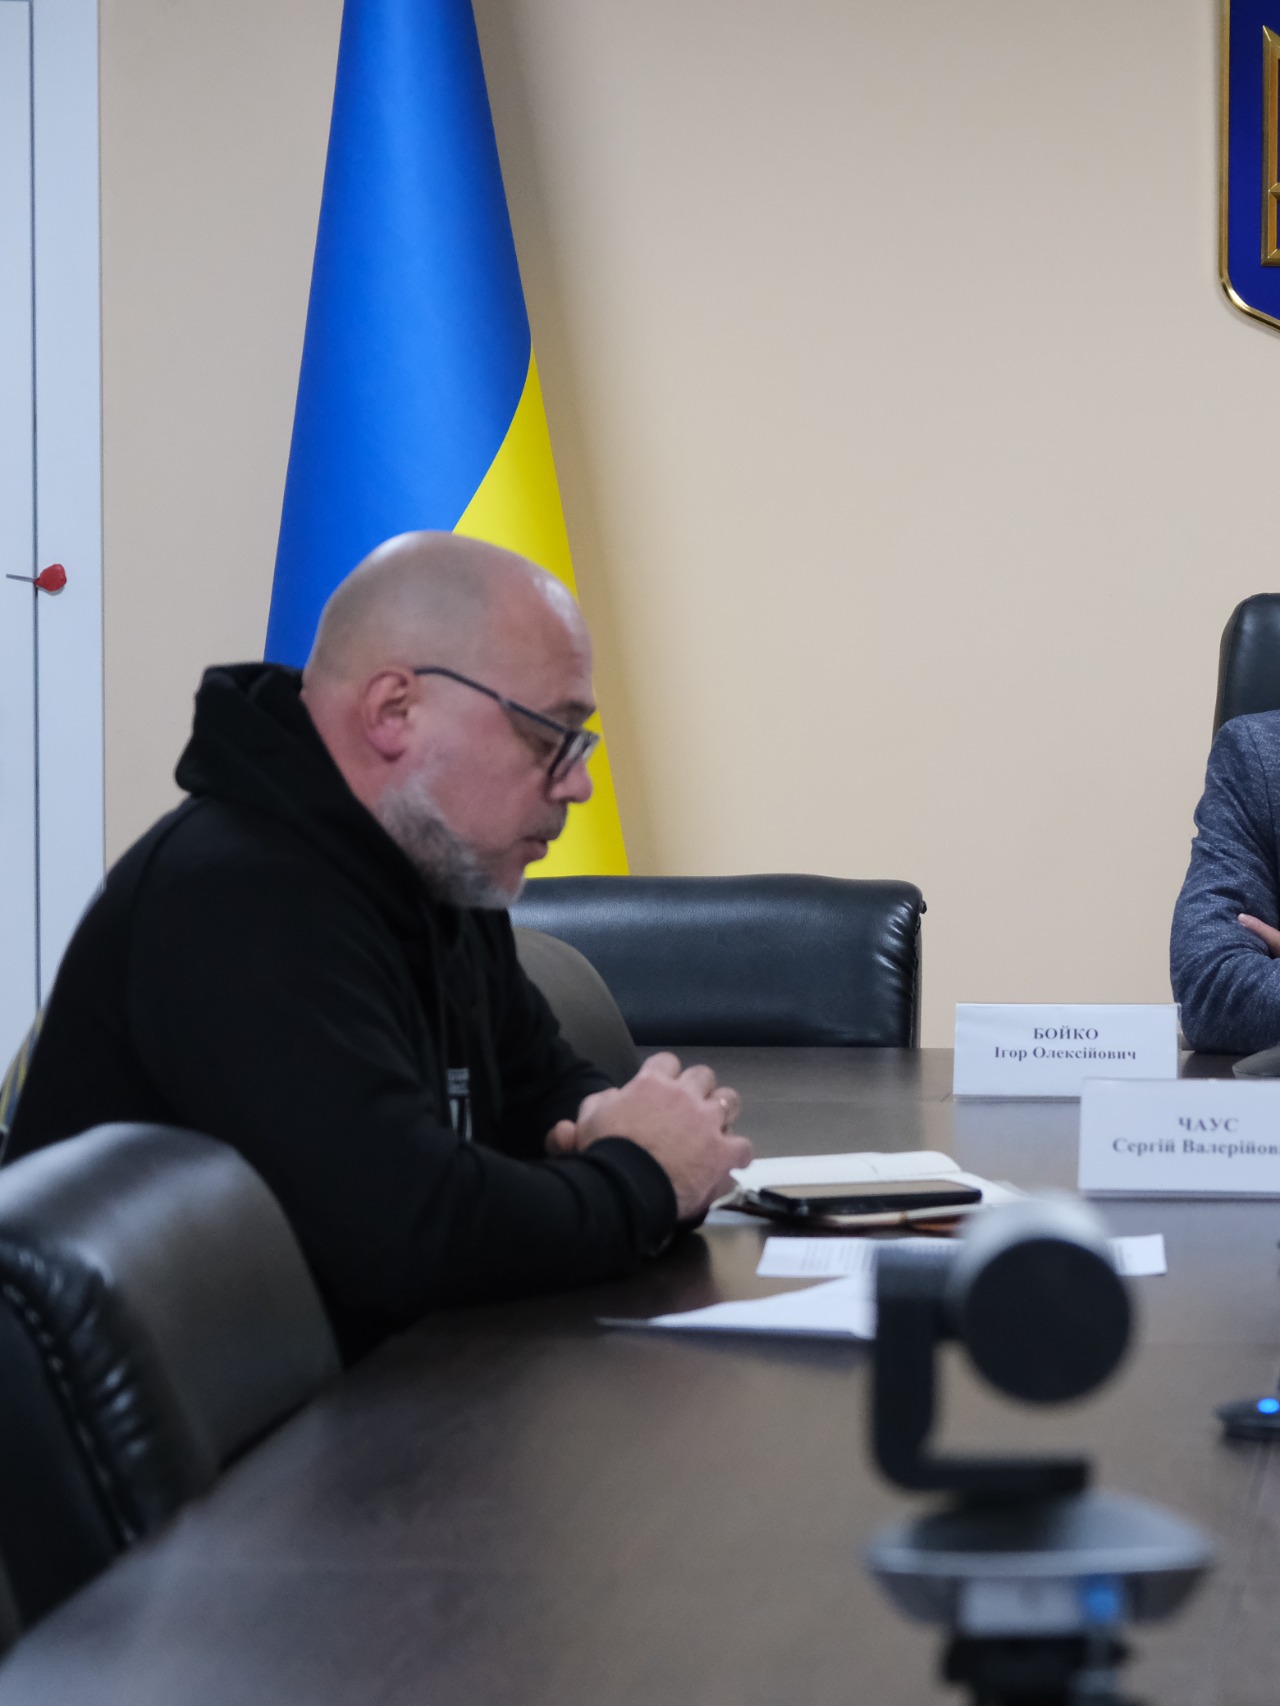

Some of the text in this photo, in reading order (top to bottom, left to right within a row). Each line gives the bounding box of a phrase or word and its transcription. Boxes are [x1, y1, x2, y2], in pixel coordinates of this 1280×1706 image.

[1033, 1025, 1099, 1040] БОЙКО
[994, 1046, 1136, 1061] Ігор Олексійович
[1178, 1116, 1239, 1132] ЧАУС
[1112, 1138, 1176, 1157] Сергій
